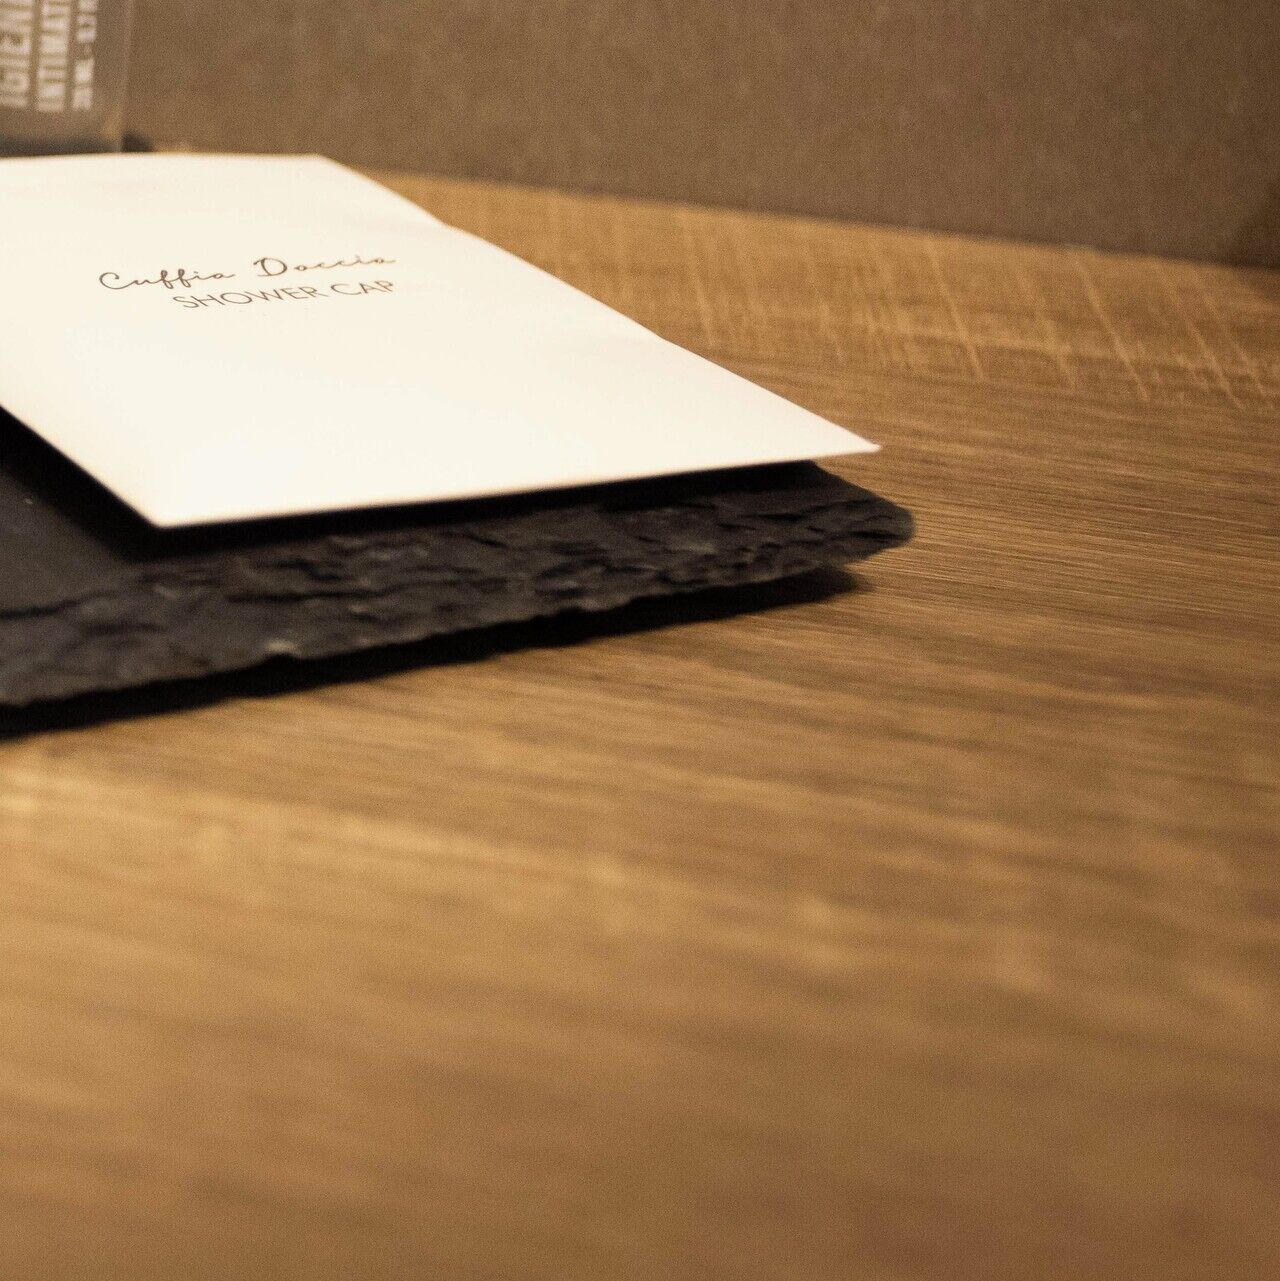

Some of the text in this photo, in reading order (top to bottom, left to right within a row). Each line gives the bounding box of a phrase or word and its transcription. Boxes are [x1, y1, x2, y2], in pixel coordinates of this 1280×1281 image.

[98, 268, 237, 291] Cuffia
[172, 278, 396, 309] SHOWER CAP
